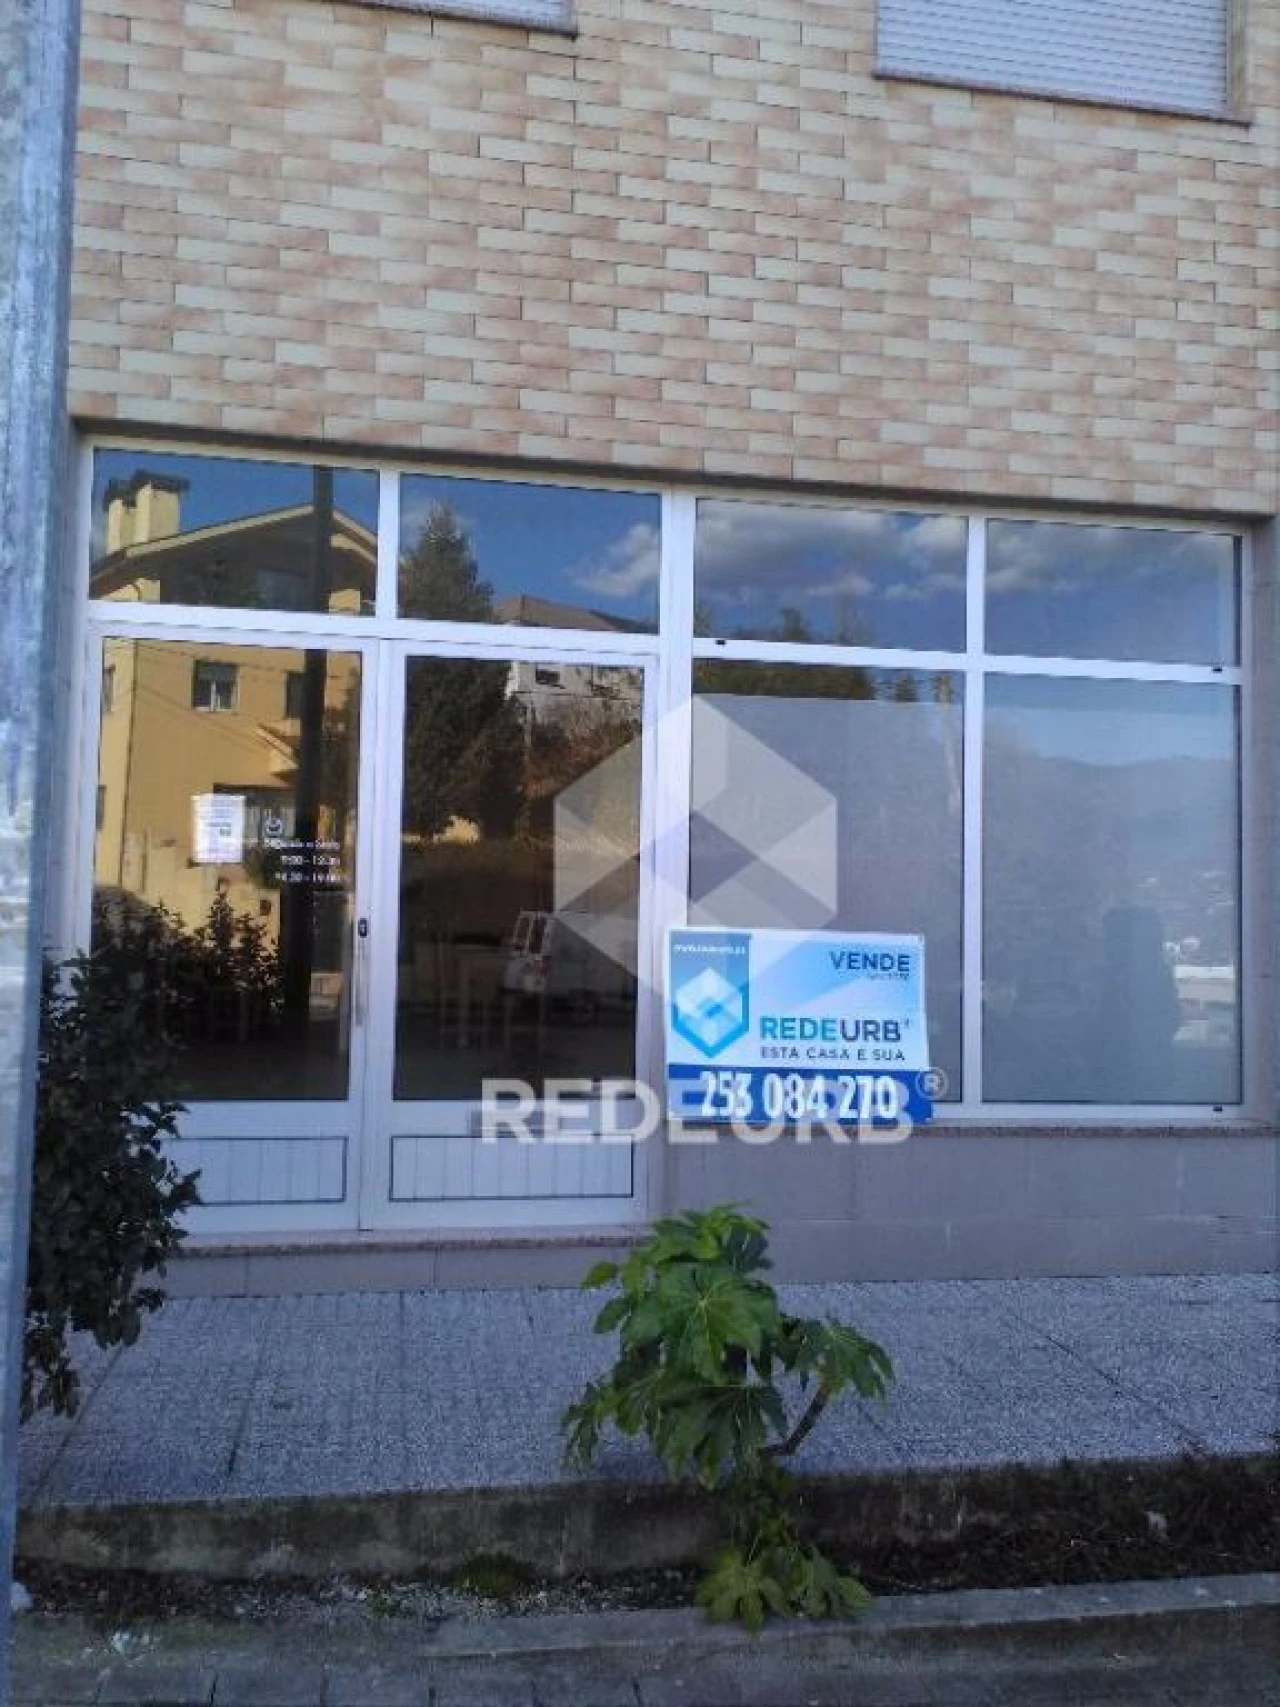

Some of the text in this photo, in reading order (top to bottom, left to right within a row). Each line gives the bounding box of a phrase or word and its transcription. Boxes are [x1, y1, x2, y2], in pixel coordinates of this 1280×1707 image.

[829, 950, 911, 972] VENDE
[760, 1016, 902, 1043] REDEURB
[759, 1046, 801, 1059] ESTA
[806, 1046, 850, 1060] CASA
[872, 1048, 906, 1061] SUA
[701, 1070, 899, 1119] 253 084 270
